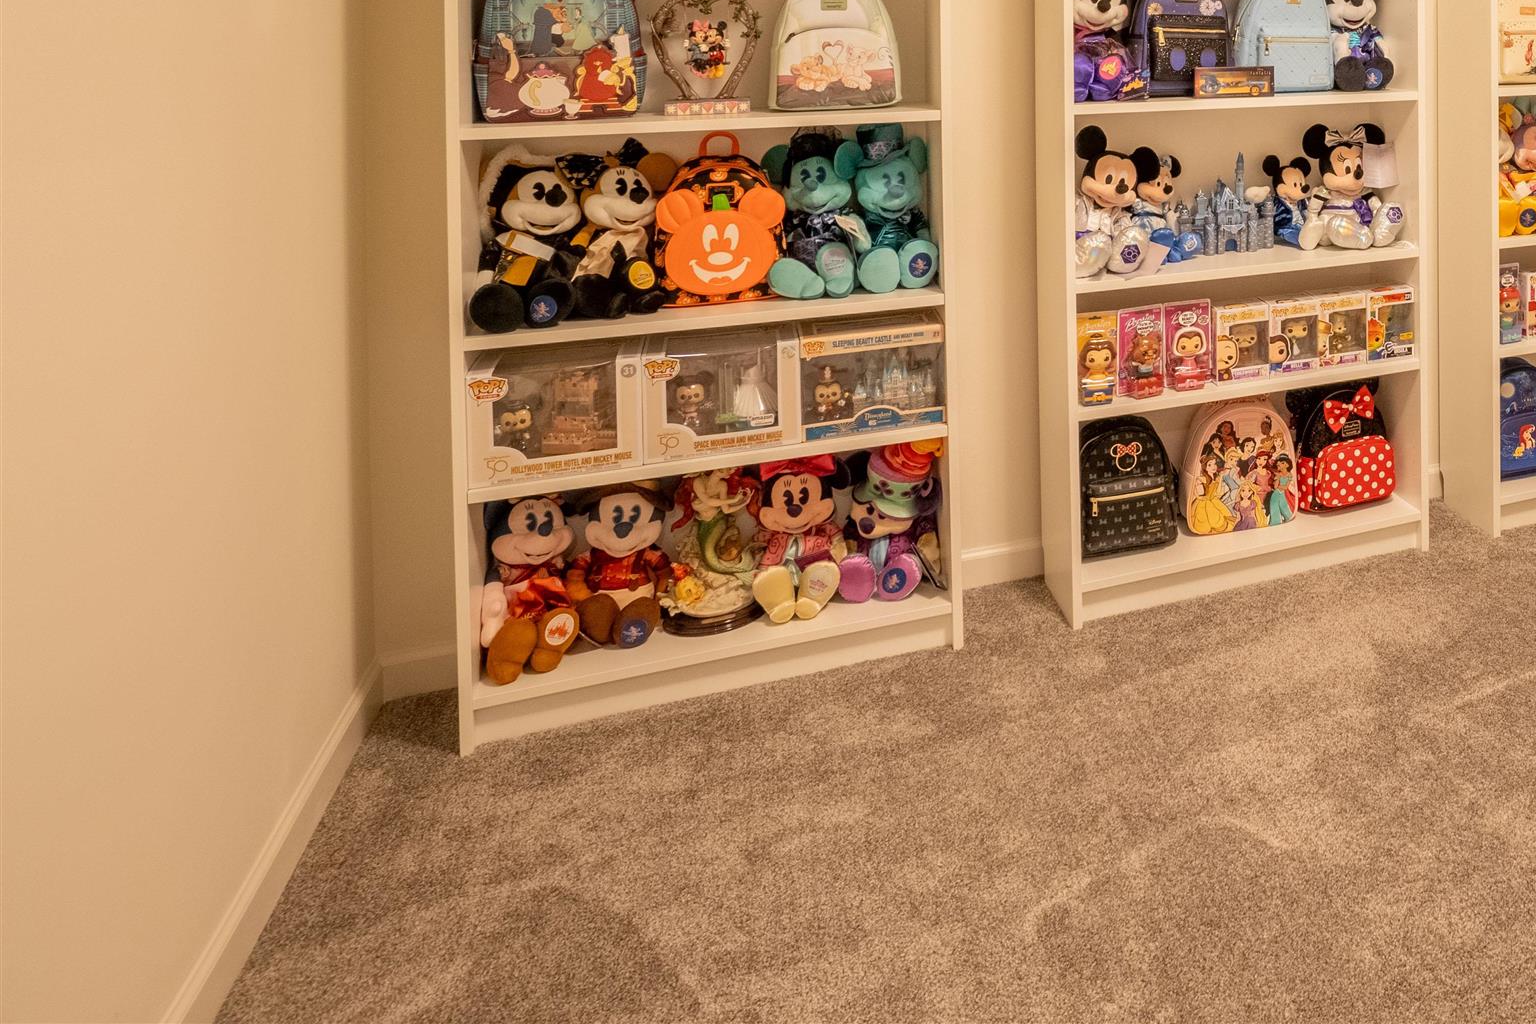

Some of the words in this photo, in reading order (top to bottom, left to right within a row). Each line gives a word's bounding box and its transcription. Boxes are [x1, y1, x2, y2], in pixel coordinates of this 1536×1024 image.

[832, 339, 855, 349] SLEEPING
[855, 337, 874, 346] BEAUTY
[874, 335, 892, 344] CASTLE
[644, 360, 678, 375] POP!
[469, 379, 506, 396] POP!
[864, 411, 892, 421] Disneyland
[694, 439, 710, 450] SPACE
[710, 436, 735, 447] MOUNTAIN
[736, 435, 747, 444] AND
[747, 433, 765, 443] MICKEY
[766, 430, 783, 440] MOUSE
[510, 463, 543, 475] HOLLYWOOD
[544, 461, 563, 471] TOWER
[564, 458, 580, 468] HOTEL
[581, 457, 592, 466] AND
[593, 455, 612, 465] MICKEY
[614, 451, 633, 462] MOUSE
